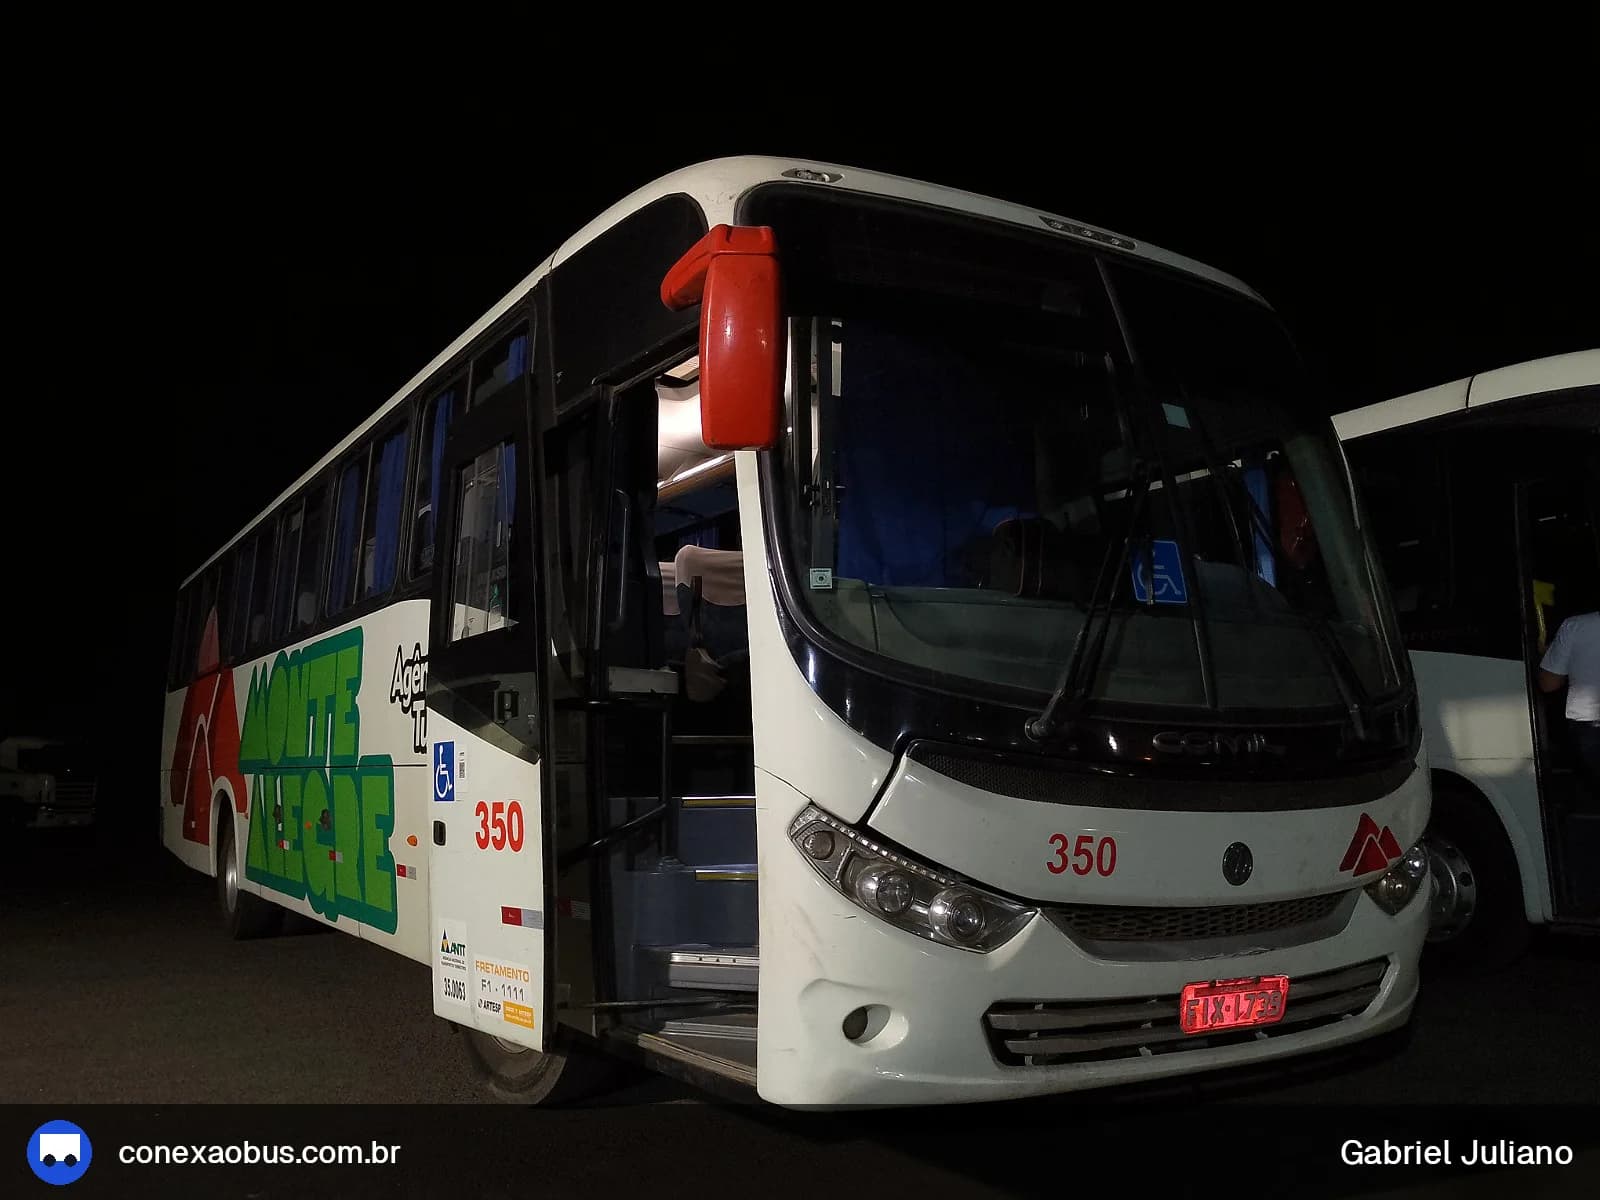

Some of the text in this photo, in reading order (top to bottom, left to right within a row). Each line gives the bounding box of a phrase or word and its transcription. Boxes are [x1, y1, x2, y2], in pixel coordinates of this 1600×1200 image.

[239, 627, 363, 772] MONTE
[475, 801, 524, 852] 350
[245, 757, 398, 932] ALEGRE
[1046, 833, 1117, 876] 350
[450, 942, 466, 957] ANTT
[475, 960, 530, 983] FRETAMENTO
[481, 979, 491, 992] F1
[501, 983, 524, 1001] 1111
[484, 1000, 501, 1014] ARTESP
